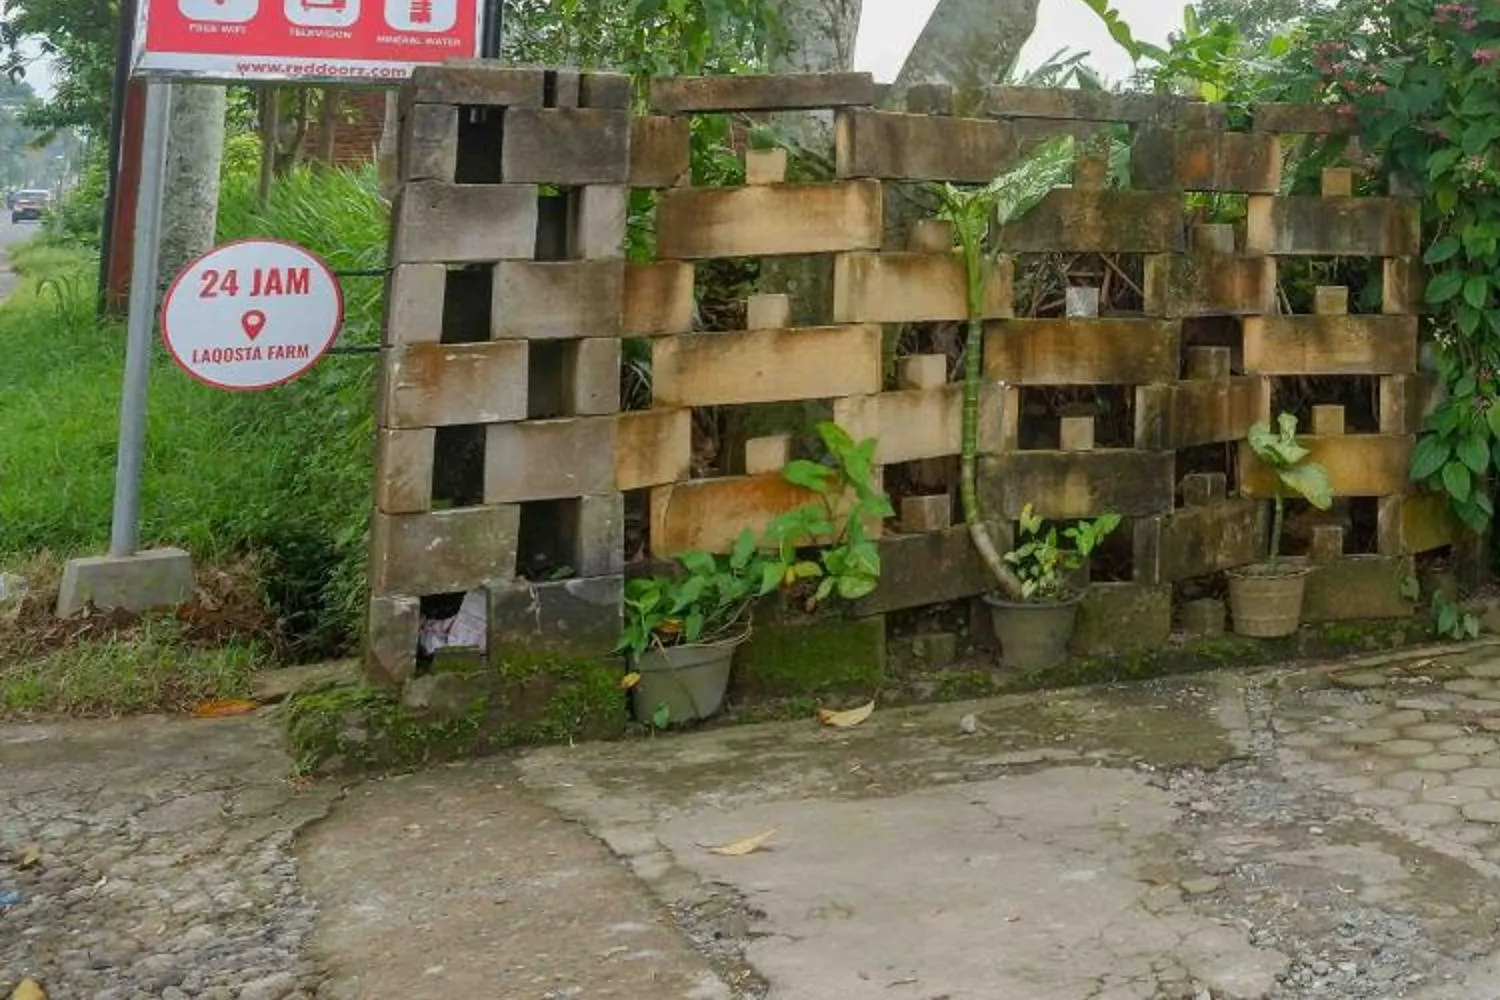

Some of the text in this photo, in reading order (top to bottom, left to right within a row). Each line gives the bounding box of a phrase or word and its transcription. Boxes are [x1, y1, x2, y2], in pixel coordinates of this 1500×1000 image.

[236, 61, 407, 78] www.reddoorz.com
[199, 267, 310, 298] 24 JAM
[192, 344, 309, 365] LAQOSTA FARM
